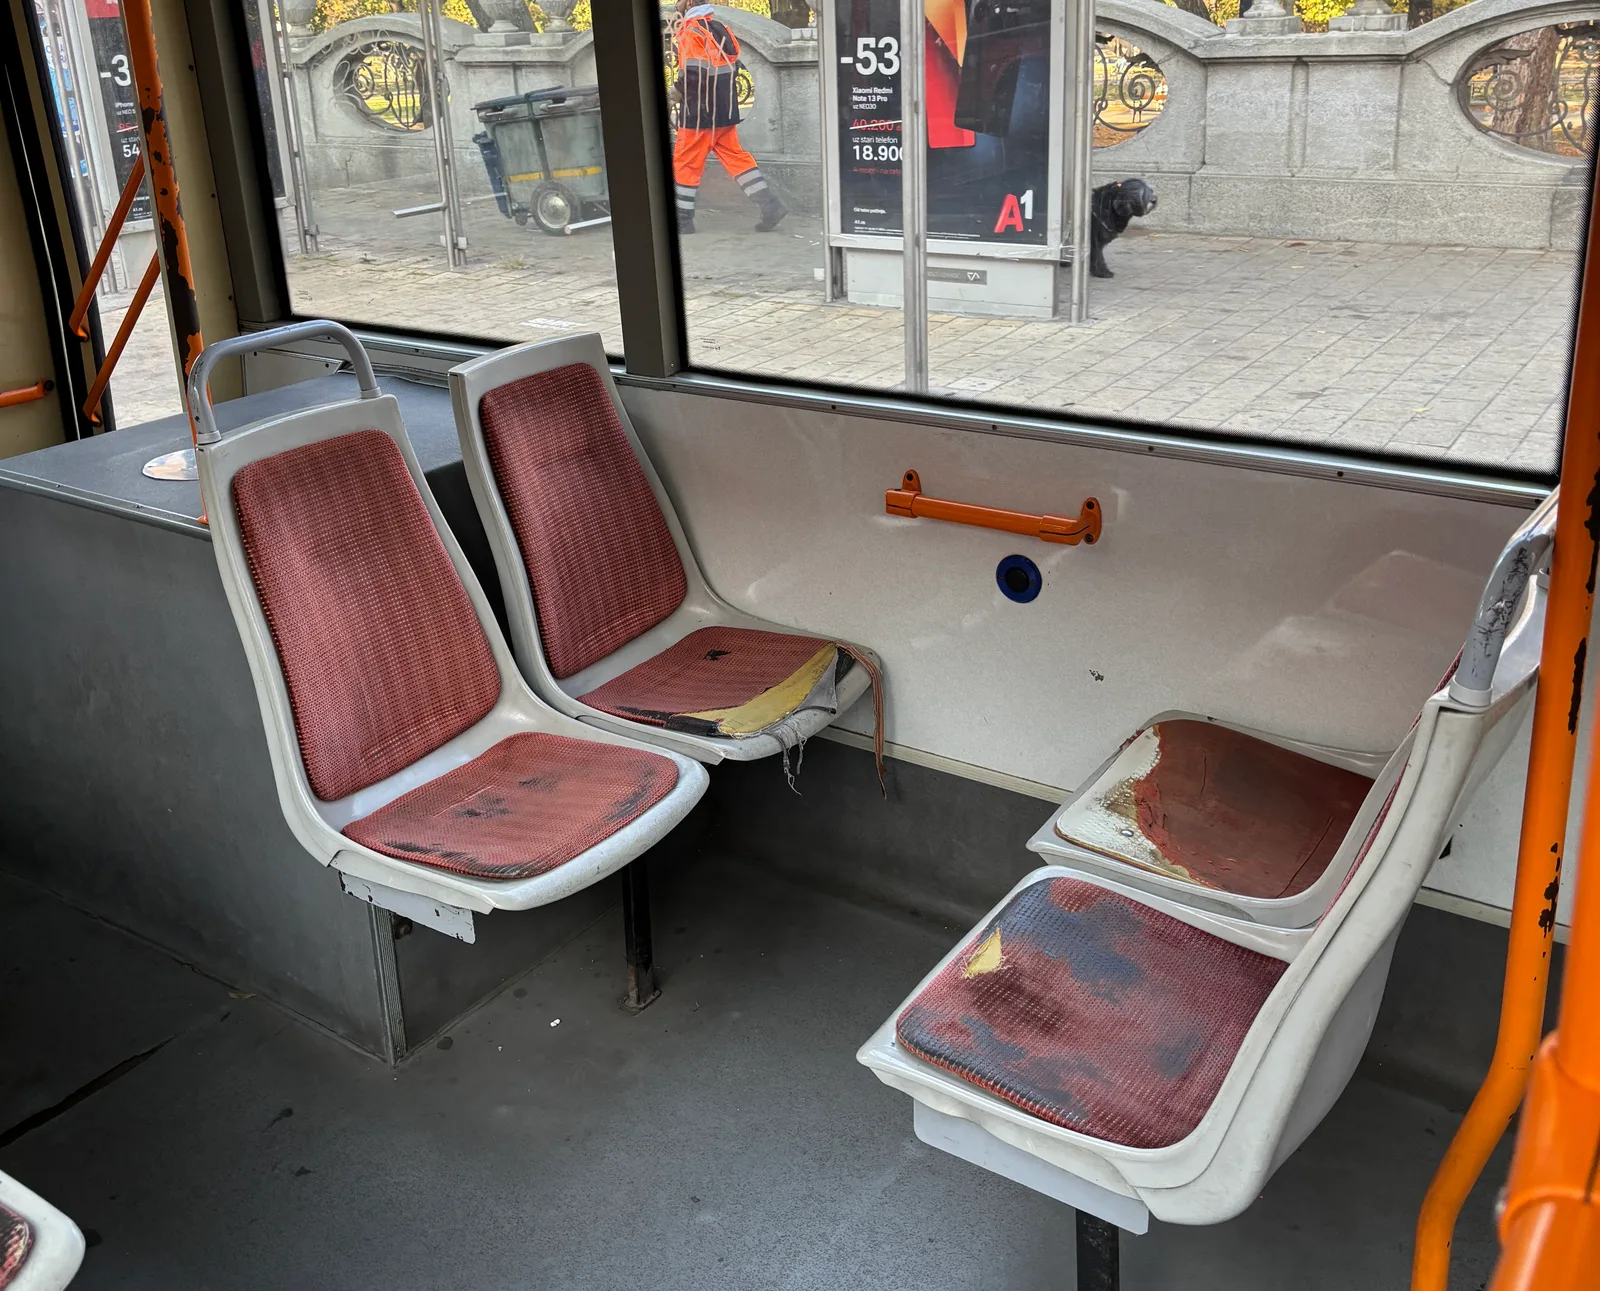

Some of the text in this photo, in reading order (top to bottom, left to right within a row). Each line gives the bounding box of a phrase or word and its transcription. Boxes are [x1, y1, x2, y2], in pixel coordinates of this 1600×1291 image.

[840, 36, 902, 76] -53
[875, 136, 898, 144] telefon
[993, 189, 1034, 234] A1
